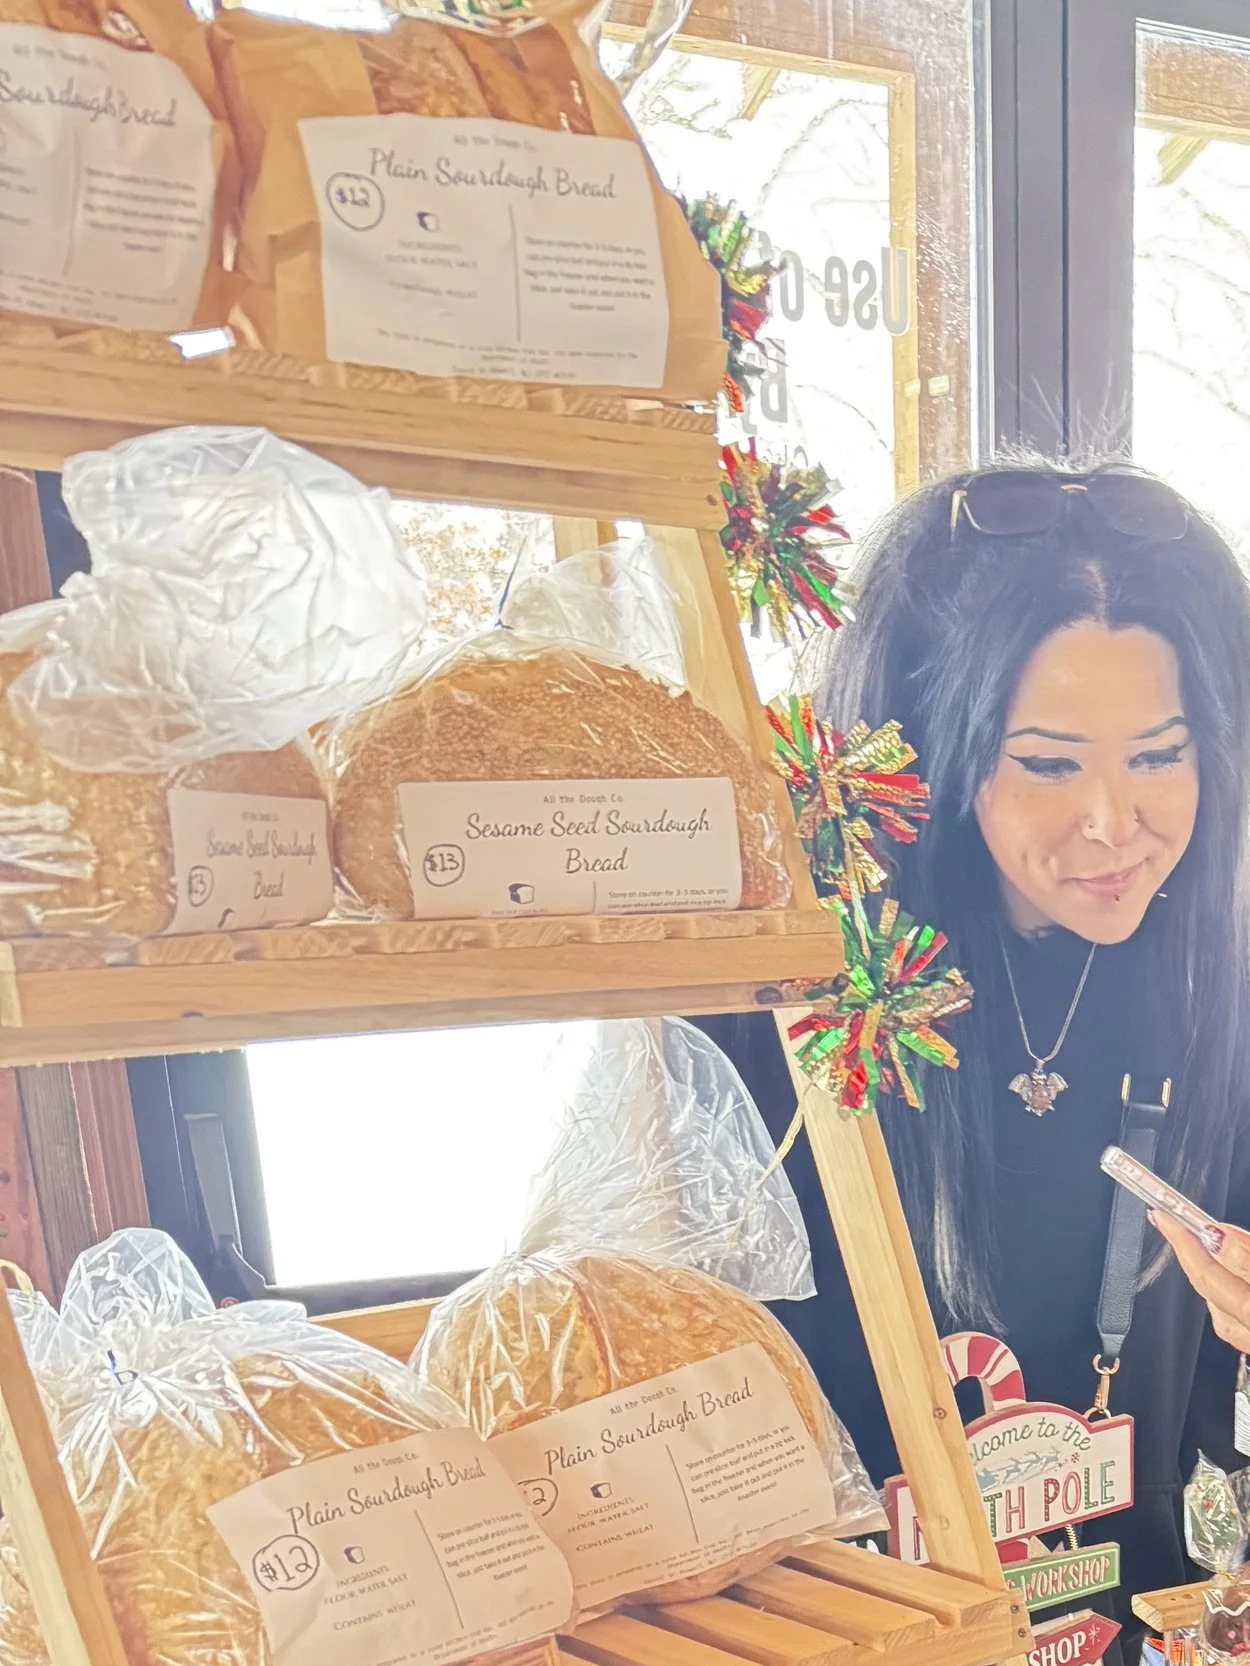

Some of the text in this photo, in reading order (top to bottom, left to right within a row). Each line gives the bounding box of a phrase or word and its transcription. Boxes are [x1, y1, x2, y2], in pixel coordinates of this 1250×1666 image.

[118, 89, 177, 127] Bread
[368, 147, 616, 198] Plain Sourdough Bread
[465, 808, 712, 840] Sesame Seed Sourdough
[427, 852, 460, 874] $13
[566, 847, 629, 874] Bread
[544, 1376, 754, 1475] Plain Sourdough Bread
[610, 1405, 624, 1416] All
[625, 1398, 639, 1411] the
[1038, 1417, 1058, 1438] to
[1063, 1421, 1091, 1451] the
[287, 1456, 486, 1534] Plain Sourdough Bread
[1044, 1460, 1115, 1522] POLE
[260, 1545, 313, 1582] $12
[1021, 1556, 1110, 1601] WORKSHOP
